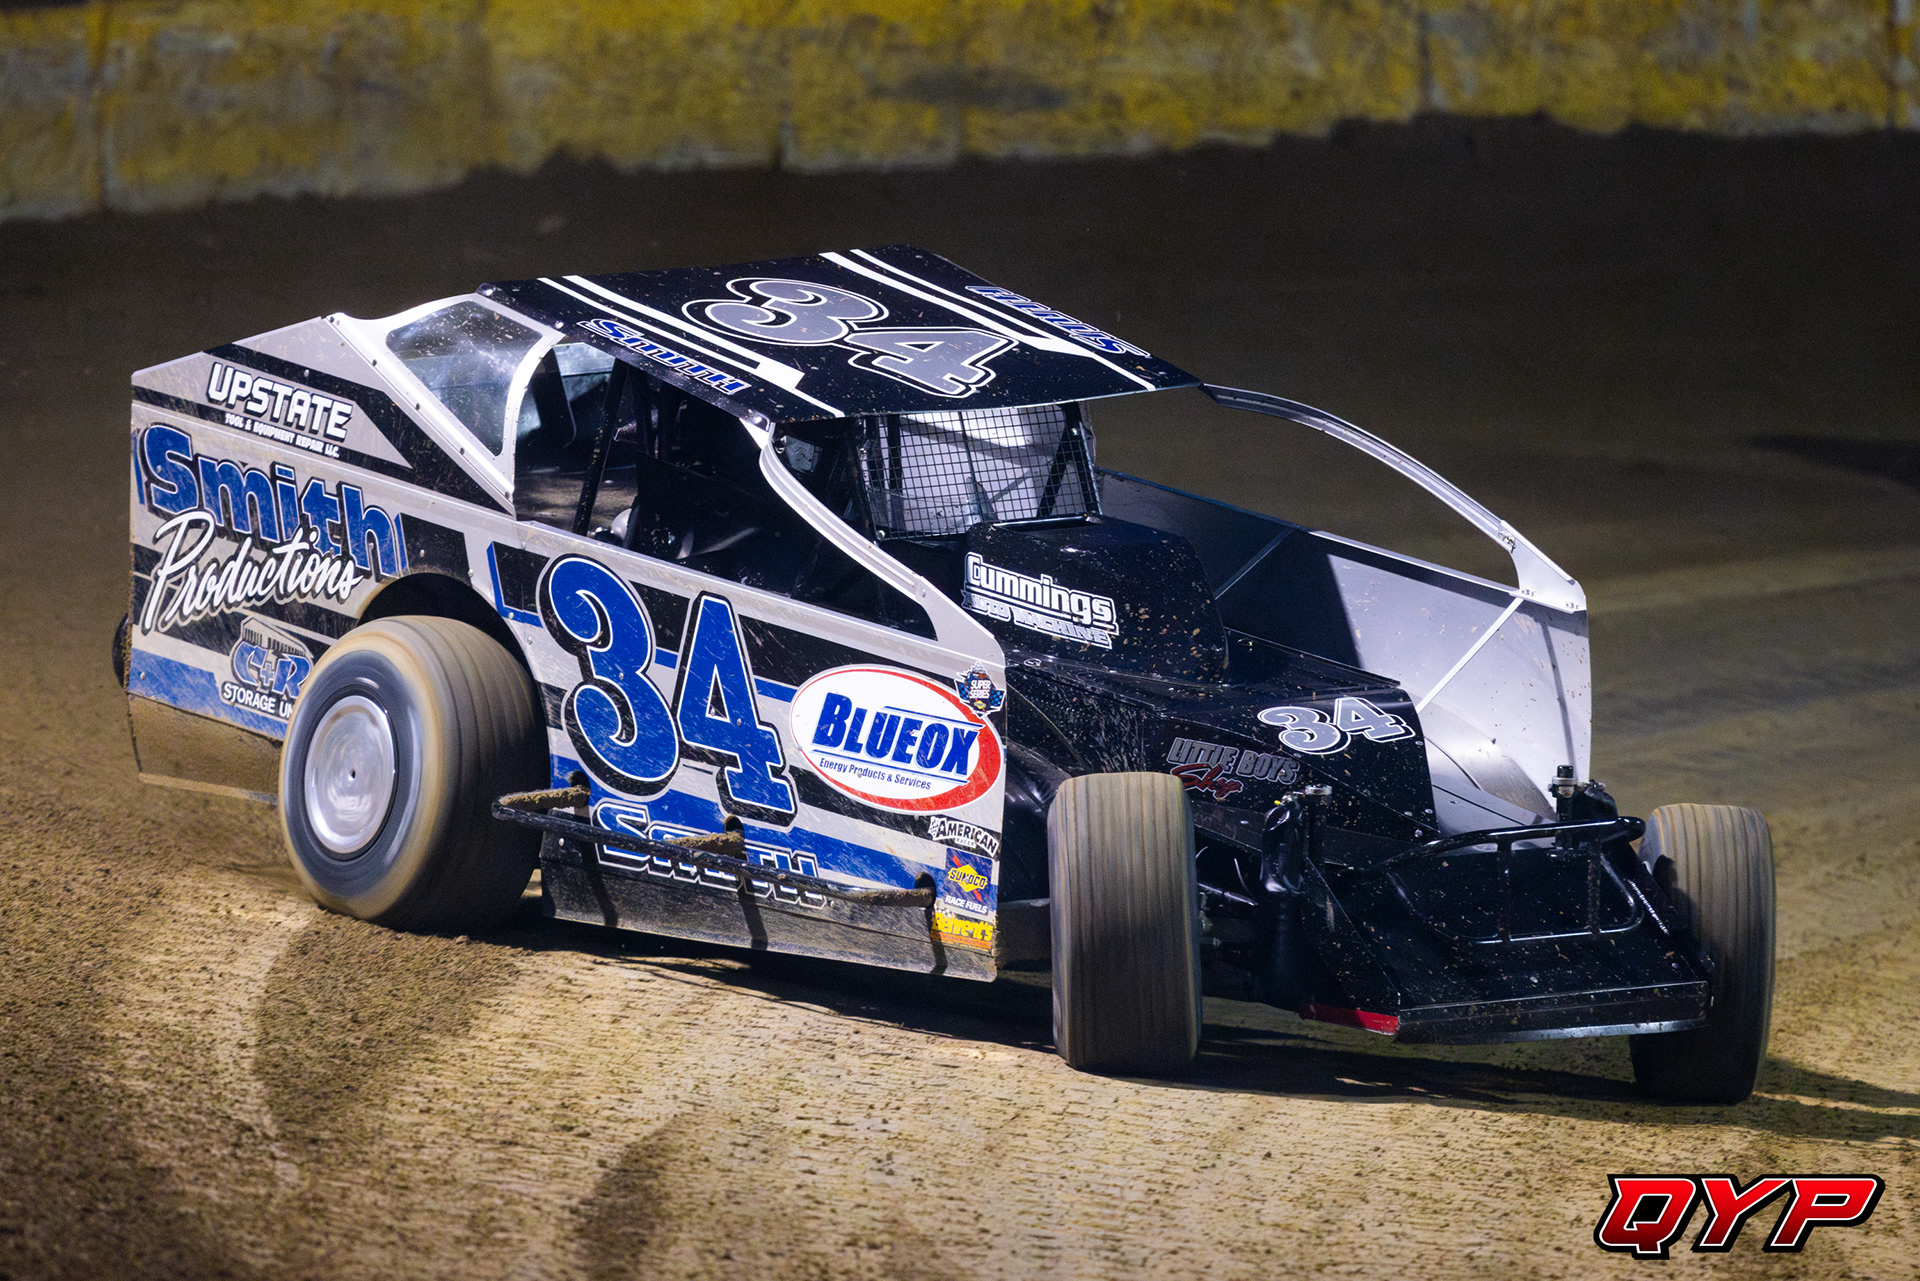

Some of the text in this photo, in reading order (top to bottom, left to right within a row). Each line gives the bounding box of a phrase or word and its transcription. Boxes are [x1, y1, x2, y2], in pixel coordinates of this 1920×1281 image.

[682, 276, 1020, 398] 34
[206, 361, 353, 442] UPSTATE
[225, 413, 244, 429] TOOL
[245, 419, 252, 431] &
[253, 422, 295, 443] EQUIPMENT
[296, 434, 324, 453] REPAIR
[140, 422, 402, 583] Smith
[141, 511, 364, 634] Productions
[965, 552, 1118, 634] Cummings
[1013, 606, 1112, 649] MACHINE
[223, 682, 276, 714] STORAGE
[538, 554, 798, 826] 34
[969, 690, 990, 699] SERIES
[971, 680, 991, 690] SUPER
[1257, 697, 1415, 755] 34
[819, 757, 932, 790] Energy Products & Services
[1167, 737, 1300, 785] LITTLE BOYS
[935, 819, 998, 854] AMERICAN
[956, 838, 975, 846] RACER
[949, 869, 986, 888] SUNOCO
[945, 895, 988, 914] RACE FUELS
